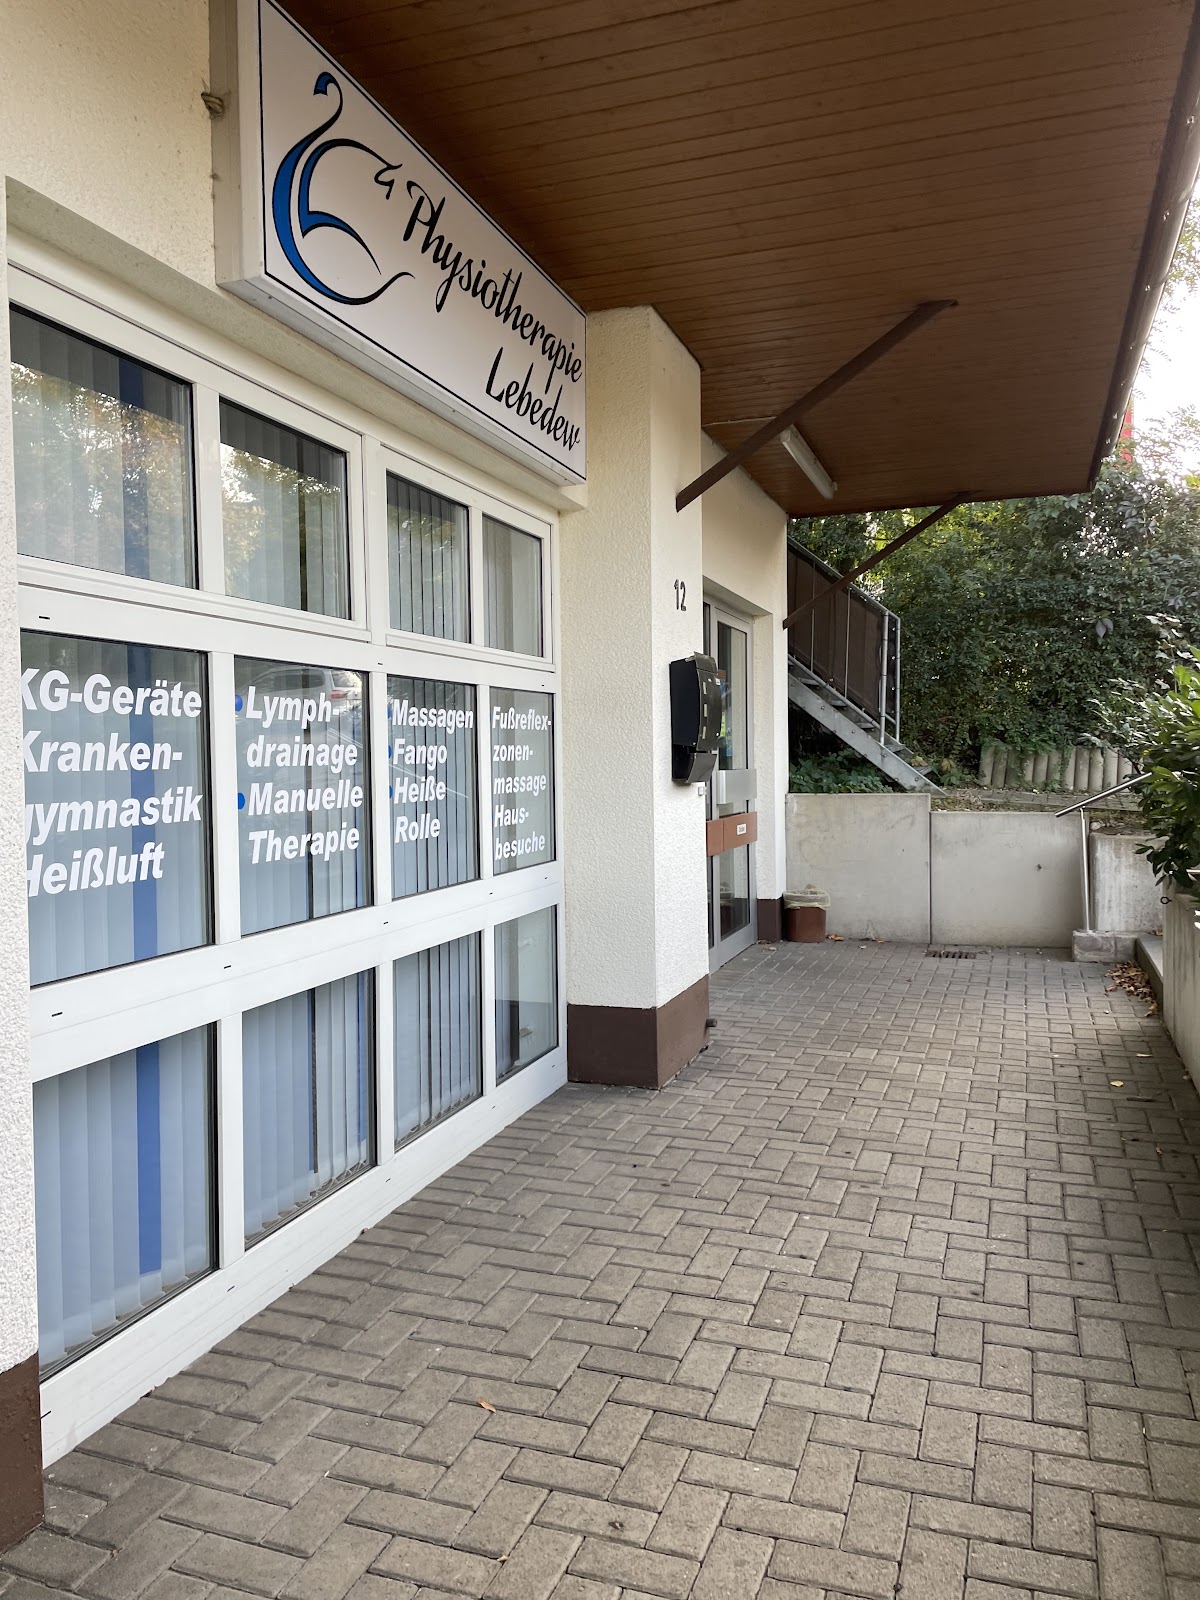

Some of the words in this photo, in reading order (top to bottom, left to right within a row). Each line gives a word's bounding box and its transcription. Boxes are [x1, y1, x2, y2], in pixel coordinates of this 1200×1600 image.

[403, 181, 582, 394] Physiotherapie
[485, 347, 581, 451] Lebedew
[673, 578, 687, 611] 12
[21, 668, 202, 718] KG-Geräte
[246, 686, 340, 729] Lymph-
[392, 699, 474, 735] Massagen
[492, 706, 552, 731] Fußreflex-
[246, 735, 358, 773] drainage
[393, 738, 448, 771] Fango
[492, 744, 534, 762] zonen-
[248, 780, 364, 816] Manuelle
[394, 777, 447, 805] Heiße
[493, 774, 547, 797] massage
[394, 814, 441, 844] Rolle
[494, 804, 530, 828] Haus-
[248, 822, 360, 865] Therapie
[495, 831, 546, 861] besuche
